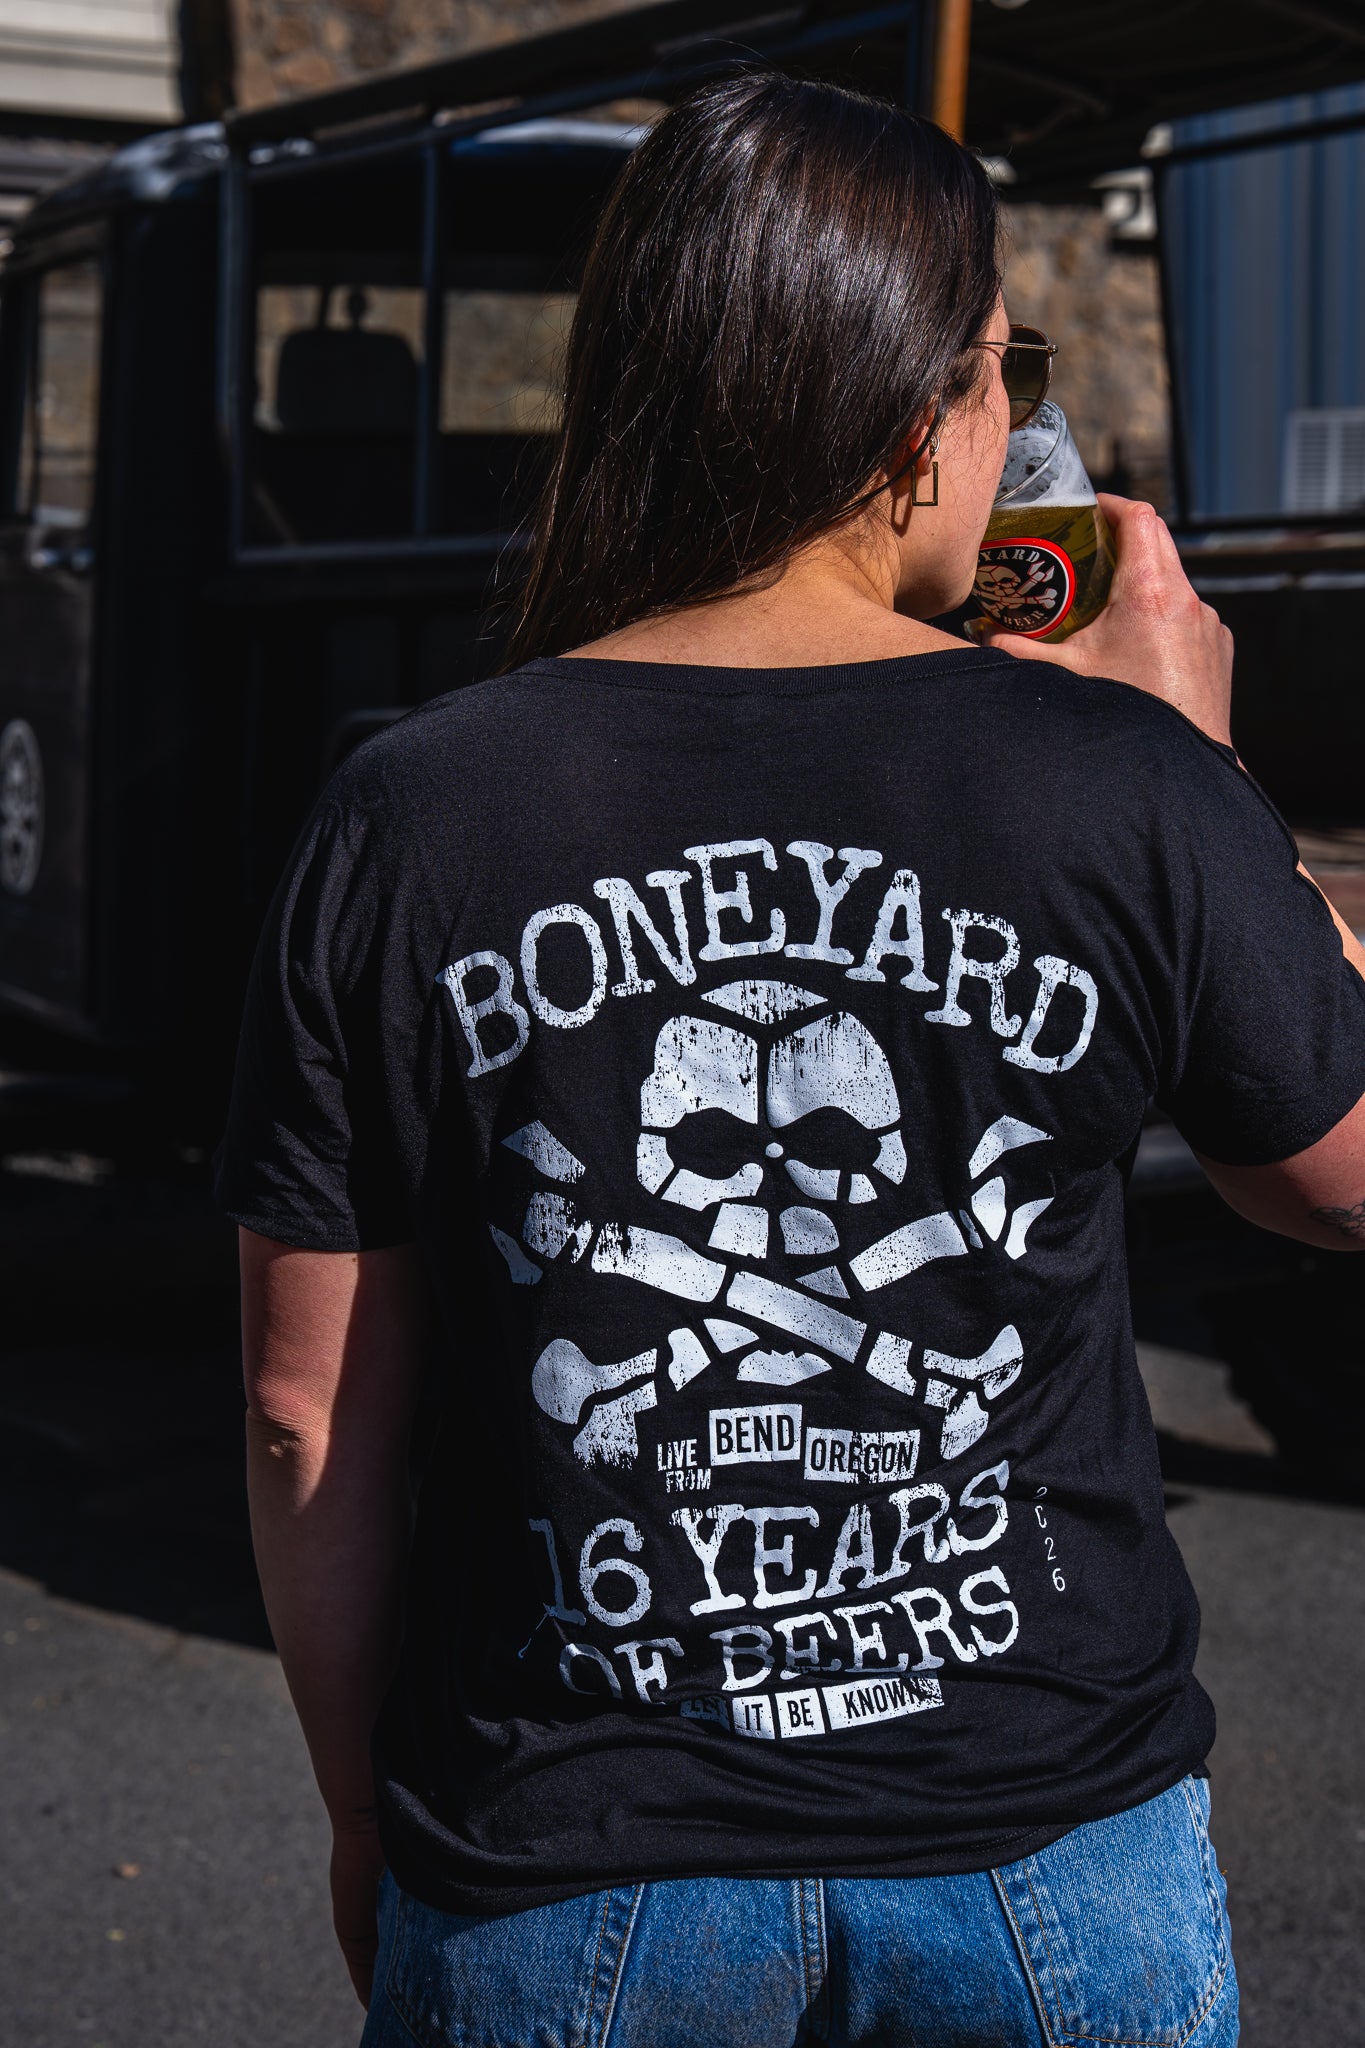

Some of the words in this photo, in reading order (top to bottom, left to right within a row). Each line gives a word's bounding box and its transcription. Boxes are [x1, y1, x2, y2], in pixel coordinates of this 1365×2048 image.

[977, 548, 1041, 563] YARD
[1003, 610, 1045, 627] BEER
[435, 838, 1100, 1078] BONEYARD
[656, 1438, 697, 1472] LIVE
[715, 1414, 795, 1456] BEND
[809, 1437, 915, 1475] OREGON
[665, 1468, 711, 1493] FROM
[528, 1517, 653, 1627] 16
[668, 1465, 1010, 1616] YEARS
[559, 1637, 684, 1705] OF
[709, 1566, 1020, 1692] BEERS
[744, 1703, 763, 1732] IT
[786, 1697, 815, 1729] BE
[842, 1677, 928, 1720] KNOWN
